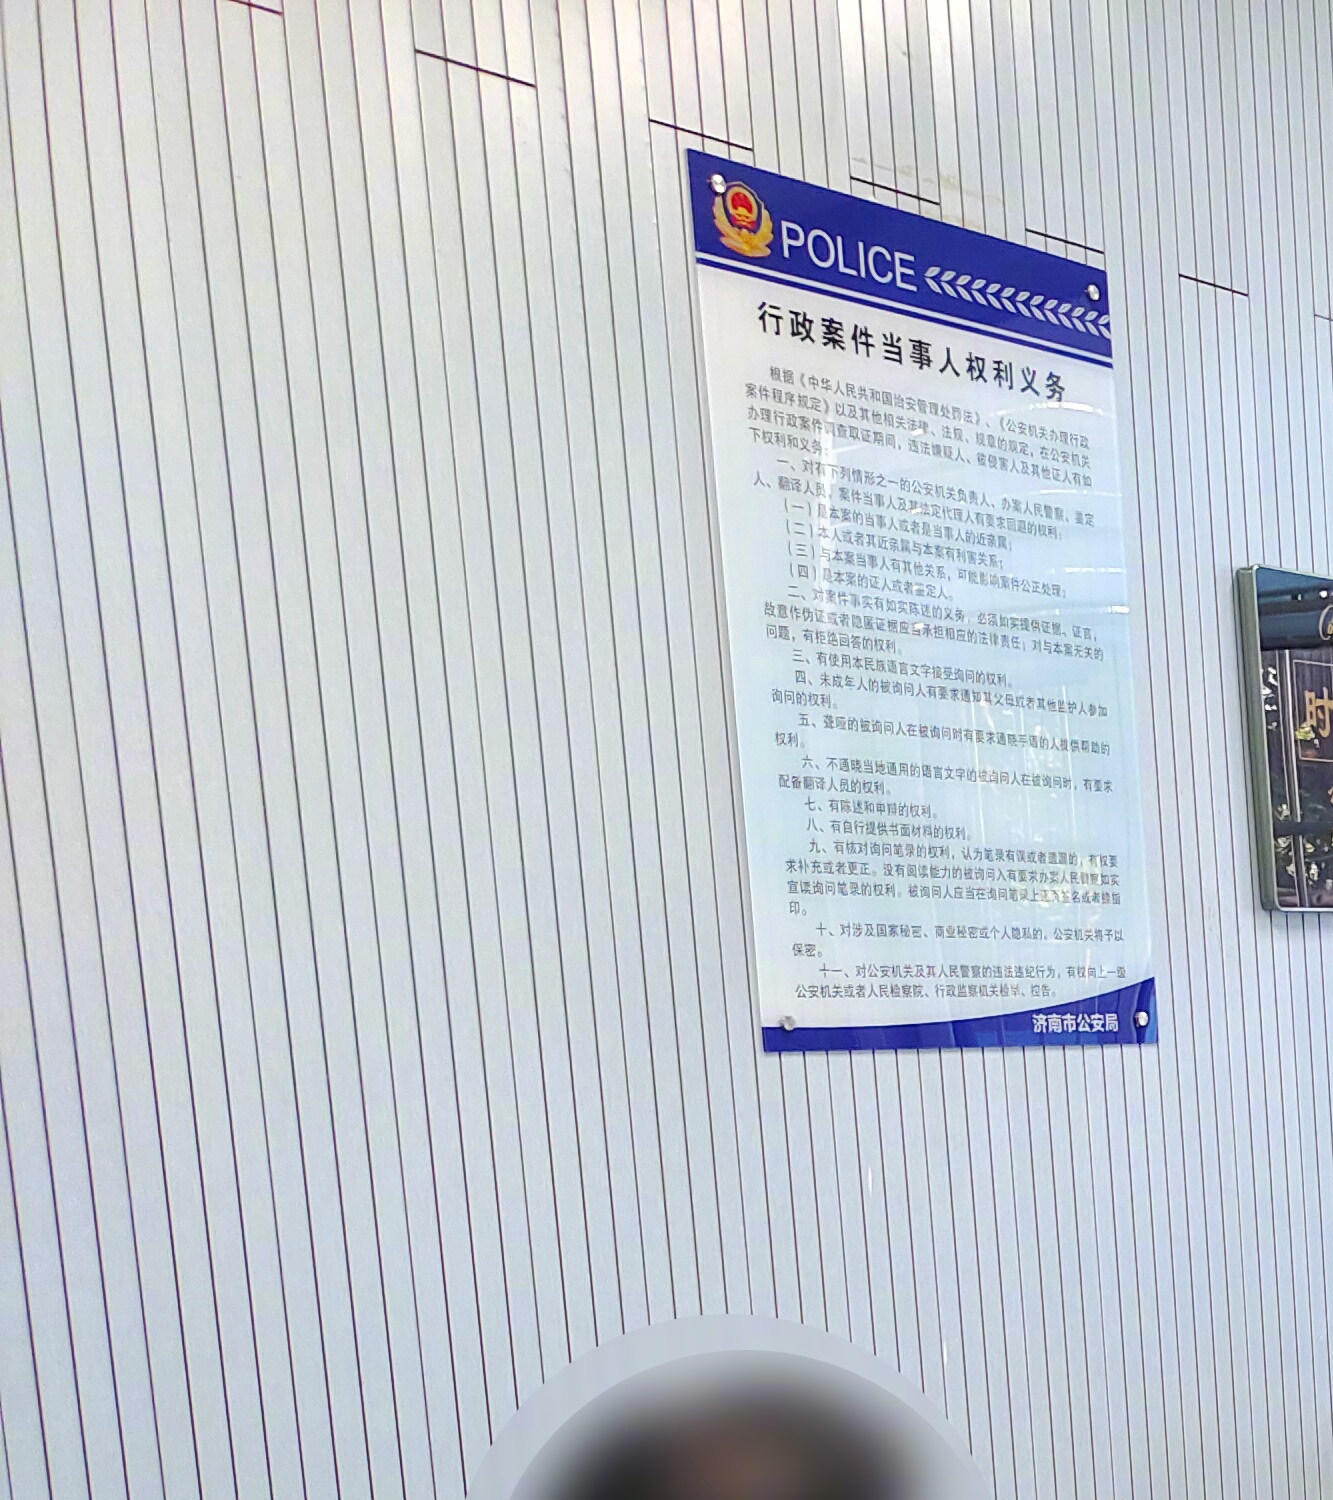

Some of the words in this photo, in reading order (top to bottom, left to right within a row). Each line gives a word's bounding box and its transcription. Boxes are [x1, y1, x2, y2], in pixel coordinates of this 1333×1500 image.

[779, 217, 917, 294] POLICE
[755, 298, 1068, 405] 行政案件当事人权利义务
[769, 687, 839, 710] 询问的权利。
[773, 730, 807, 749] 权利。
[790, 941, 825, 958] 保密。
[1030, 1011, 1120, 1037] 济南市公安局
